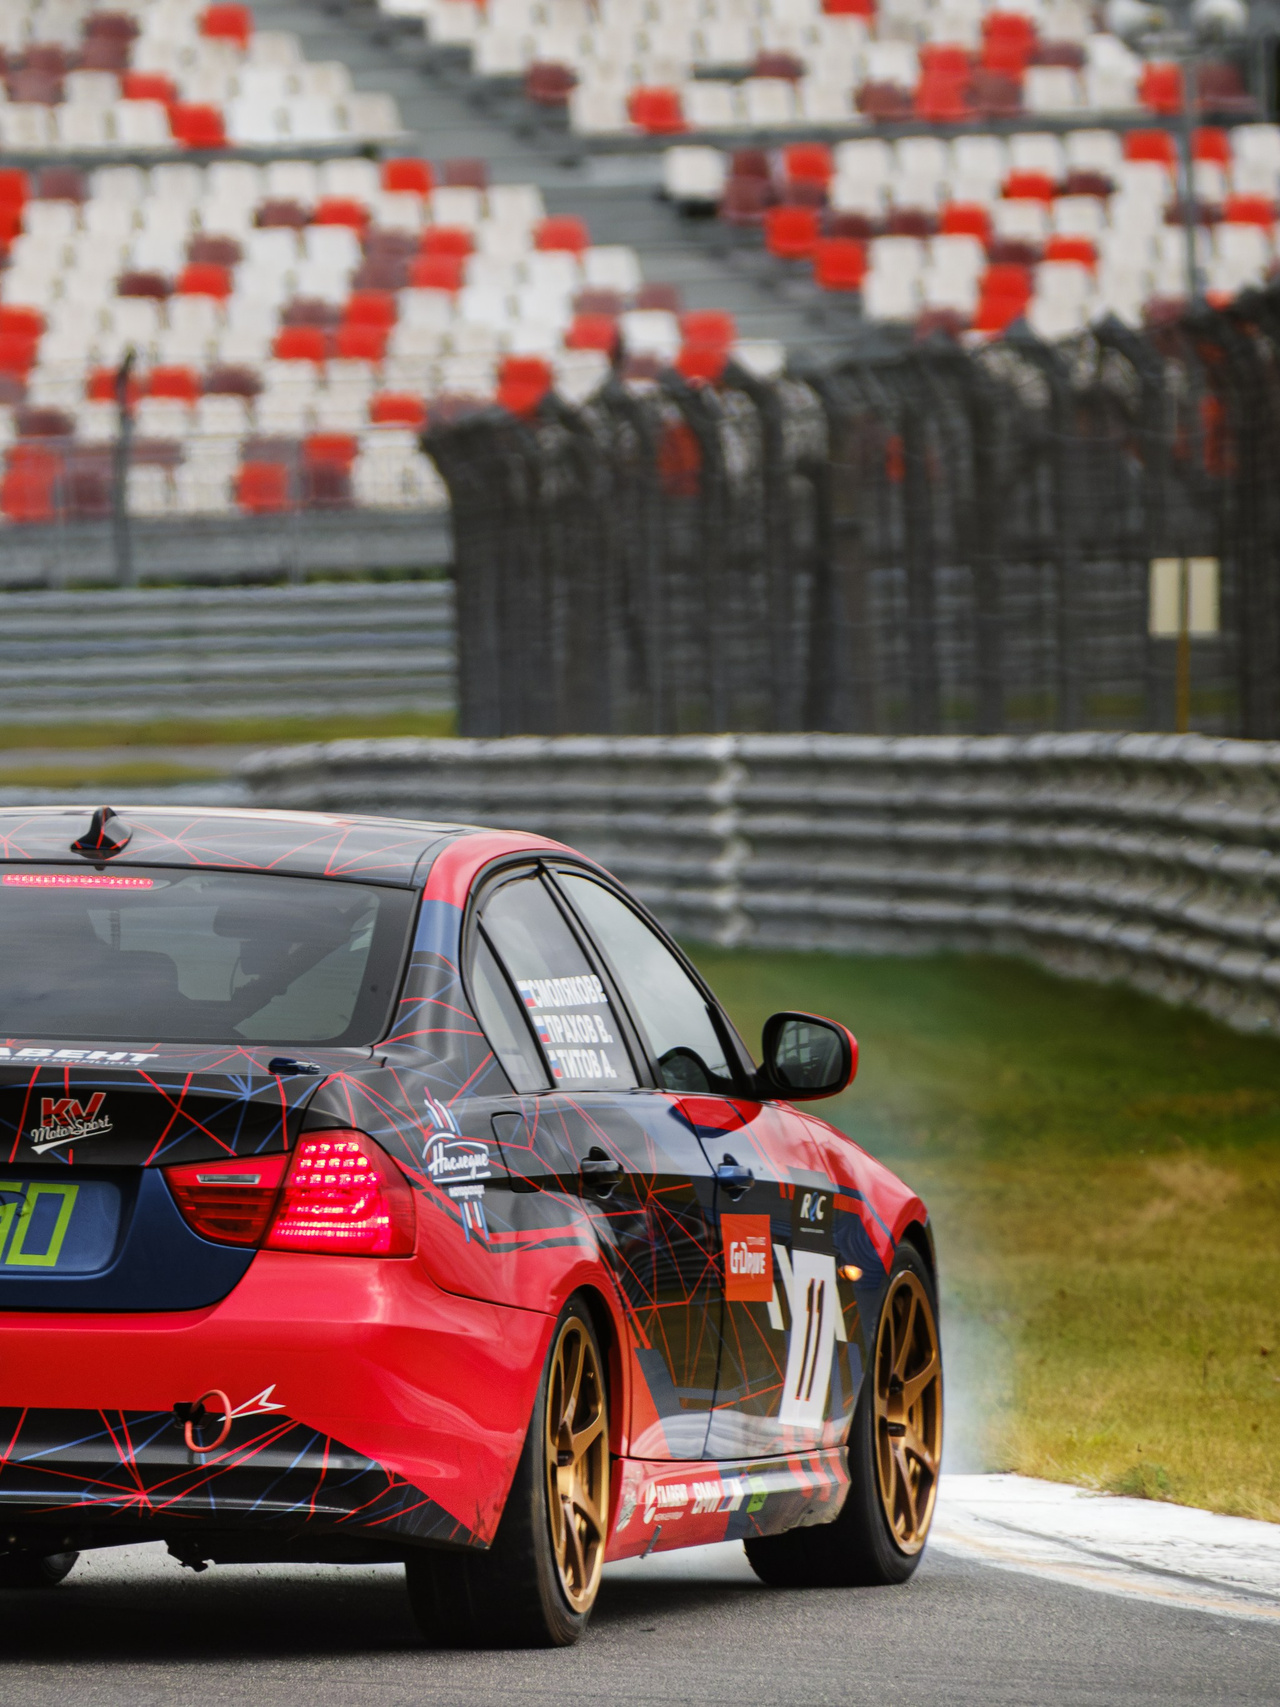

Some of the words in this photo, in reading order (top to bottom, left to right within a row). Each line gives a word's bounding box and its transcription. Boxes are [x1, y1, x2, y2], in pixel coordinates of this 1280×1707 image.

[542, 1015, 599, 1044] ПРАХОВ
[555, 1049, 603, 1078] ТИТОВ
[794, 1278, 825, 1401] 11
